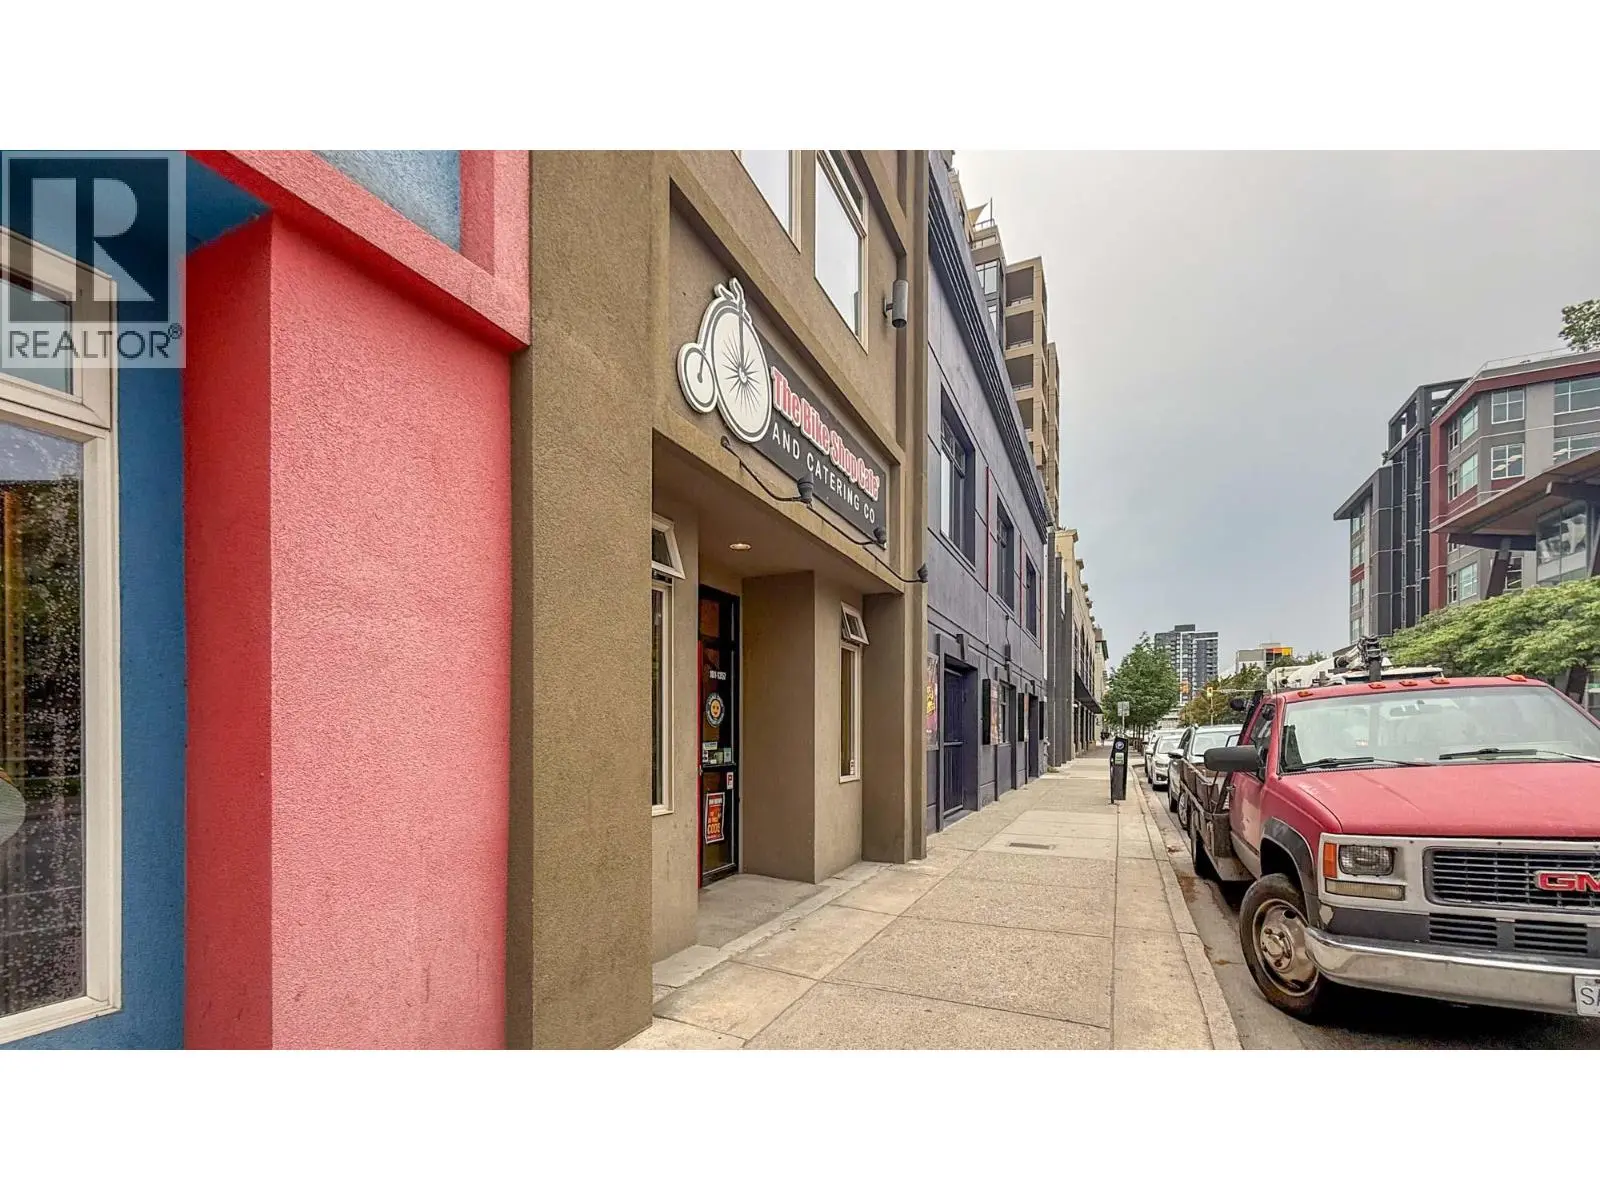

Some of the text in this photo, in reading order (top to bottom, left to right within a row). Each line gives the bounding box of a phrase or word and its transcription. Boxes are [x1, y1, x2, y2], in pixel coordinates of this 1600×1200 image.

[771, 366, 801, 427] The
[801, 398, 830, 456] Bike
[830, 430, 858, 483] Shop
[772, 422, 876, 524] AND CATERING CO
